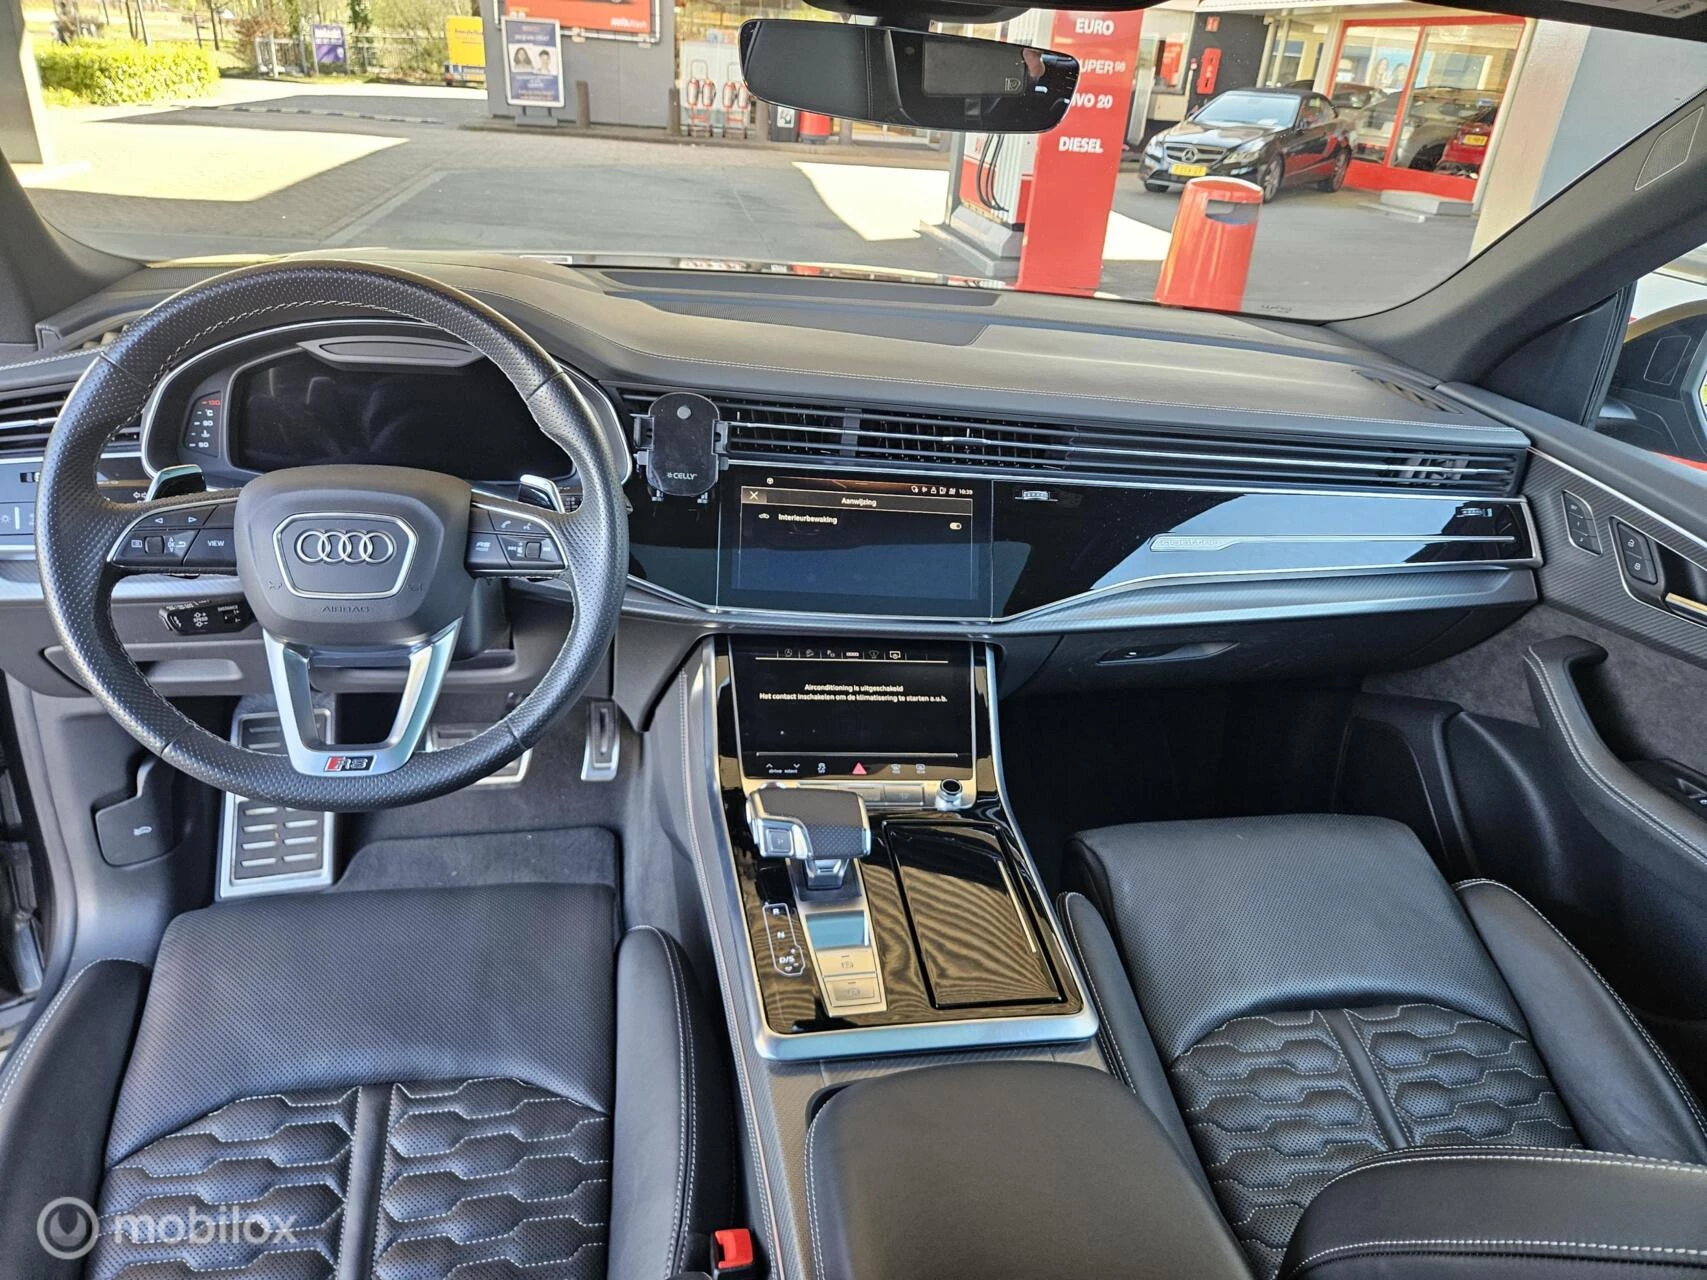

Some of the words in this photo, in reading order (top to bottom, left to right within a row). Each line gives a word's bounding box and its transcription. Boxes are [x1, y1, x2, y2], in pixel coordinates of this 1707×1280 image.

[1075, 18, 1115, 36] EURO
[1079, 60, 1114, 74] UPER
[1096, 94, 1113, 109] 20
[1058, 136, 1104, 153] DIESEL
[673, 472, 695, 480] CELLY
[841, 497, 877, 507] Aanwijzing
[778, 513, 838, 525] Interieurbewaking
[804, 683, 853, 692] Airconditioning
[860, 685, 904, 693] uitgeschakeld
[759, 692, 772, 700] Het
[856, 694, 898, 703] klimatisering
